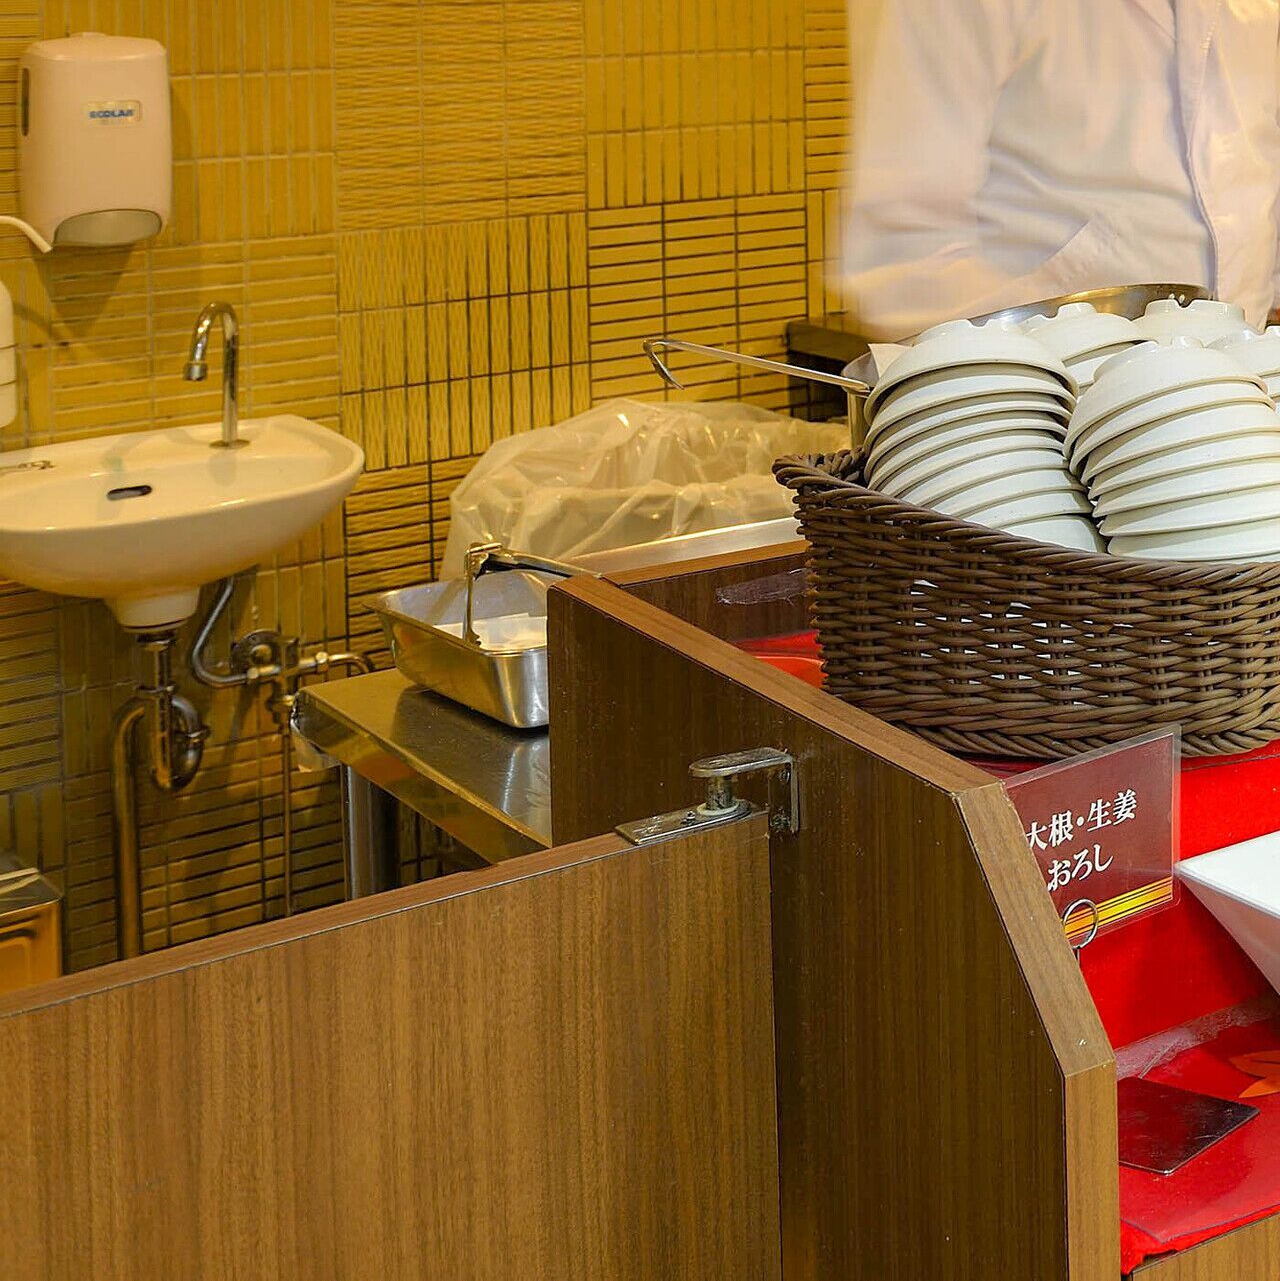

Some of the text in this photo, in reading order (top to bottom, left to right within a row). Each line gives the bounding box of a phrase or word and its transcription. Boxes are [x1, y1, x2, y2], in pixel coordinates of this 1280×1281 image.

[1026, 788, 1138, 851] 大根・生姜
[1047, 843, 1114, 892] おろし
